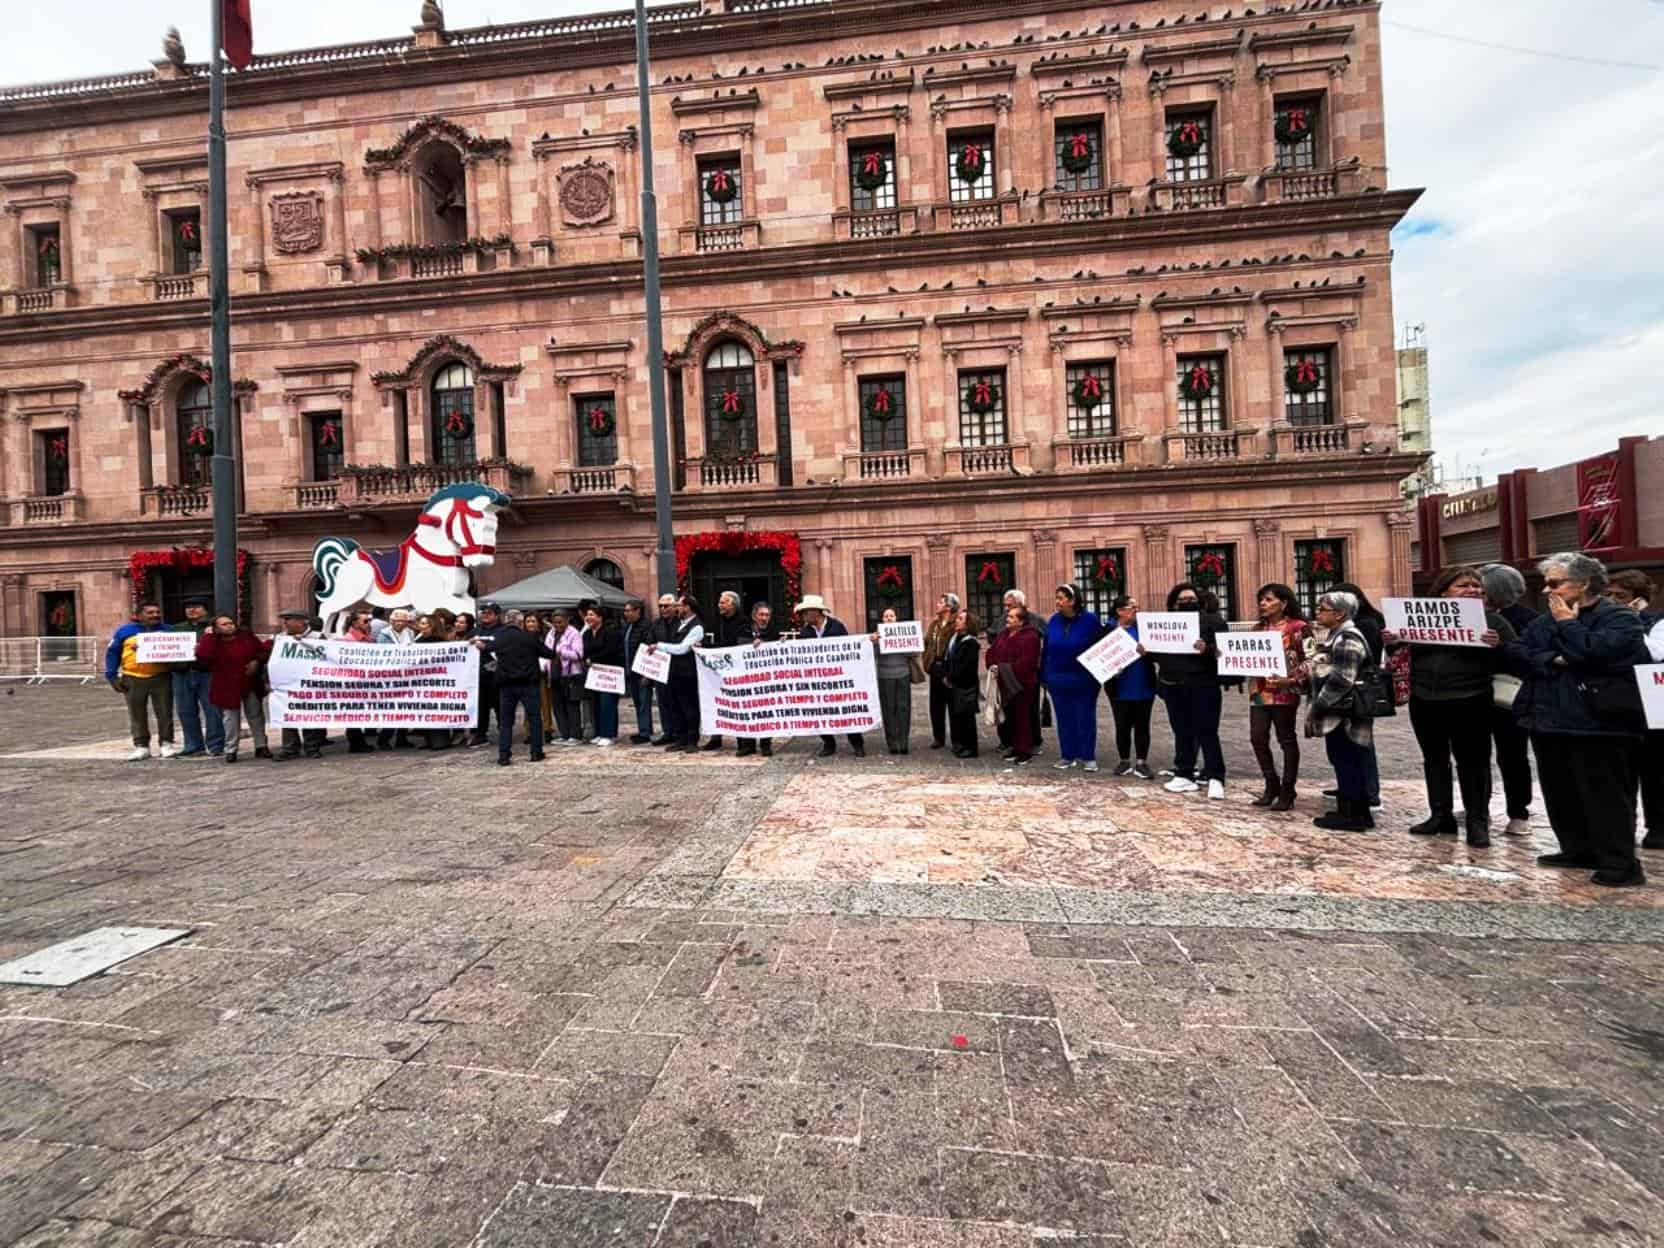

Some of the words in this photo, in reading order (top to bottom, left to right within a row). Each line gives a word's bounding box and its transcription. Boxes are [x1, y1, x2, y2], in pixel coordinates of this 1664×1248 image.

[1404, 601, 1461, 614] RAMOS
[1147, 622, 1188, 630] MONCLOVA
[1407, 615, 1463, 628] ARIZPE
[884, 625, 917, 637] SALTILLO
[1150, 633, 1185, 641] PRESENTE
[1399, 628, 1475, 642] PRESENTE
[884, 637, 920, 648] PRESENTE
[1228, 639, 1272, 651] PARRAS
[1225, 656, 1279, 669] PRESENTE
[312, 666, 366, 678] SEGURIDAD
[368, 669, 402, 678] SOCIAL
[404, 667, 448, 677] INTEGRAL
[723, 672, 771, 685] SEGURIDAD
[773, 670, 802, 680] SOCIAL
[804, 667, 844, 677] INTEGRAL
[392, 680, 409, 688] SIN
[411, 679, 456, 687] RECORTES
[754, 683, 787, 695] SEGURA
[788, 683, 793, 691] Y
[795, 682, 810, 691] SIN
[811, 680, 854, 690] RECORTES
[288, 691, 312, 699] PAGO
[315, 691, 328, 699] DE
[330, 691, 369, 699] SEGURO
[380, 690, 414, 699] TIEMPO
[423, 690, 468, 699] COMPLETO
[742, 697, 775, 709] SEGURO
[777, 696, 783, 704] A
[785, 695, 814, 703] TIEMPO
[823, 691, 868, 702] COMPLETO
[339, 702, 365, 710] PARA
[367, 702, 396, 710] TENER
[398, 702, 439, 710] VIVIENDA
[440, 702, 466, 711] DIGNA
[752, 710, 774, 720] PARA
[776, 708, 800, 717] TENER
[802, 706, 840, 716] VIVIENDA
[842, 704, 869, 714] DIGNA
[283, 713, 331, 721] SERVICIO
[425, 714, 470, 722] COMPLETO
[783, 721, 789, 729] A
[790, 720, 819, 729] TIEMPO
[821, 720, 826, 728] Y
[829, 717, 873, 728] COMPLETO
